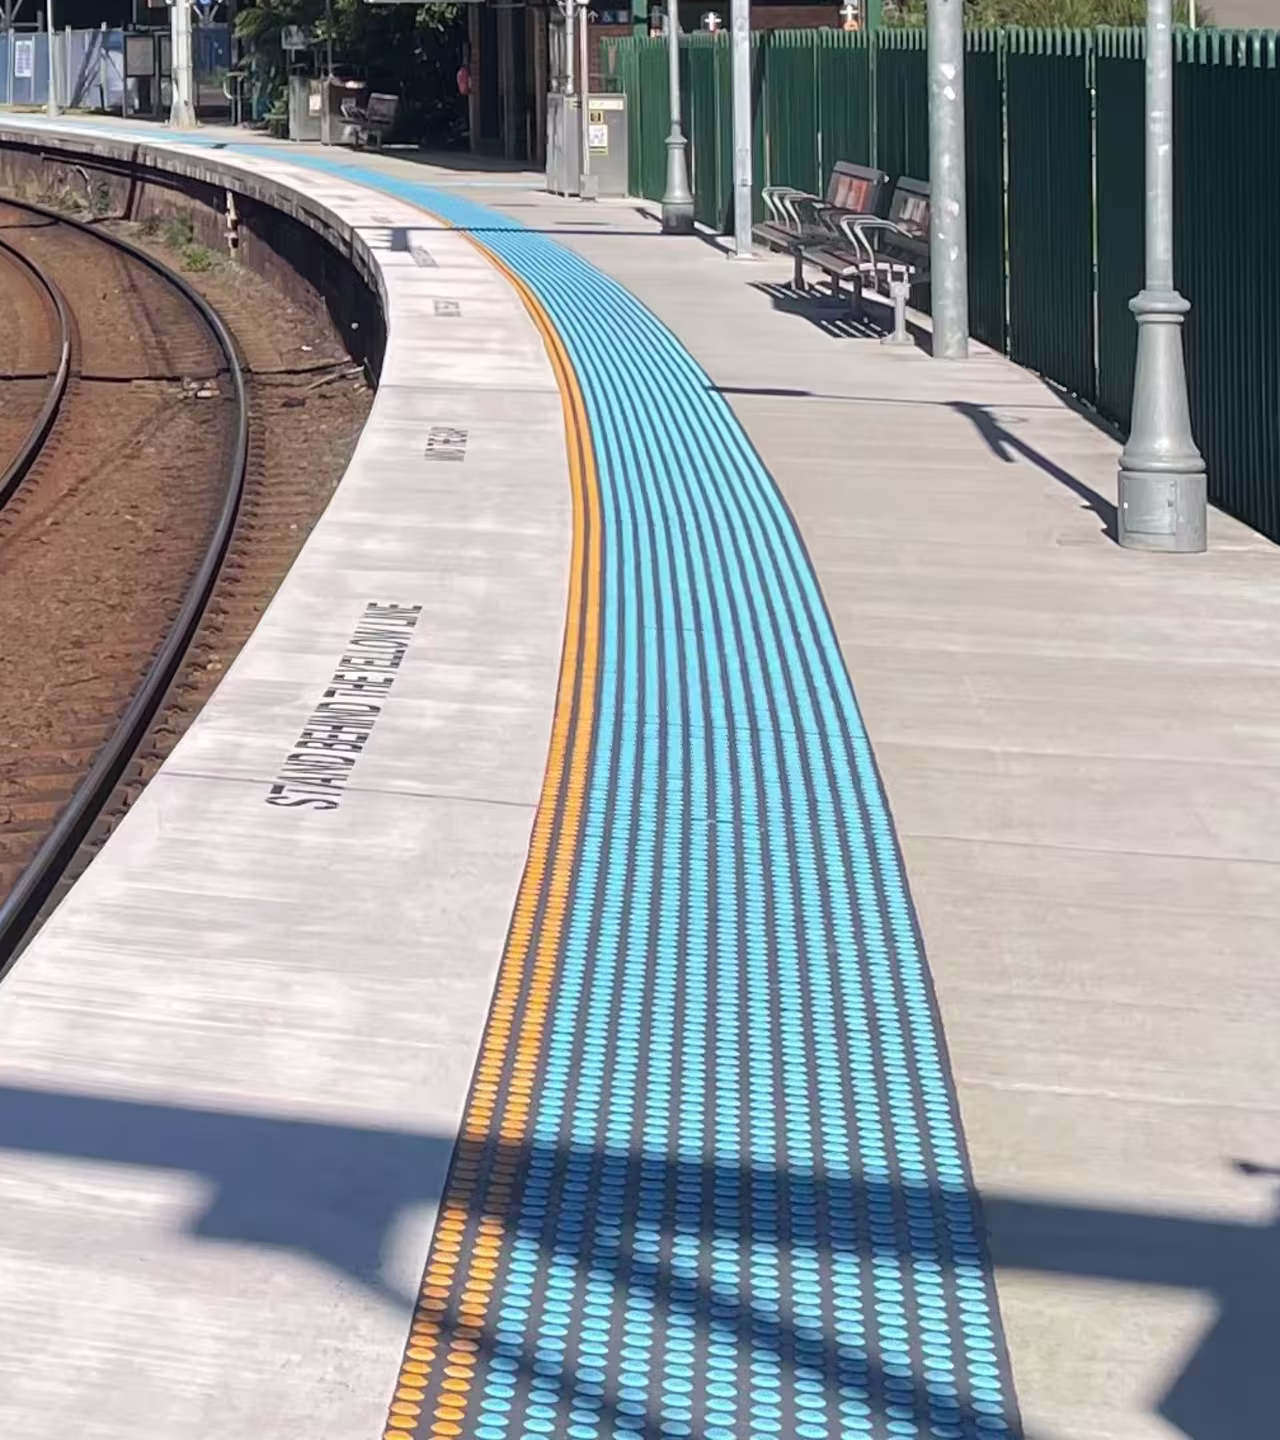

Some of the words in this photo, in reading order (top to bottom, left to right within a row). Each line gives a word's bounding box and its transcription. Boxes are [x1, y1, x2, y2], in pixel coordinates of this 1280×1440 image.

[360, 602, 422, 626] LINE
[335, 626, 414, 674] YELLOW
[322, 673, 394, 698] THE
[294, 701, 382, 753] BEHIND
[265, 753, 356, 810] STAND
